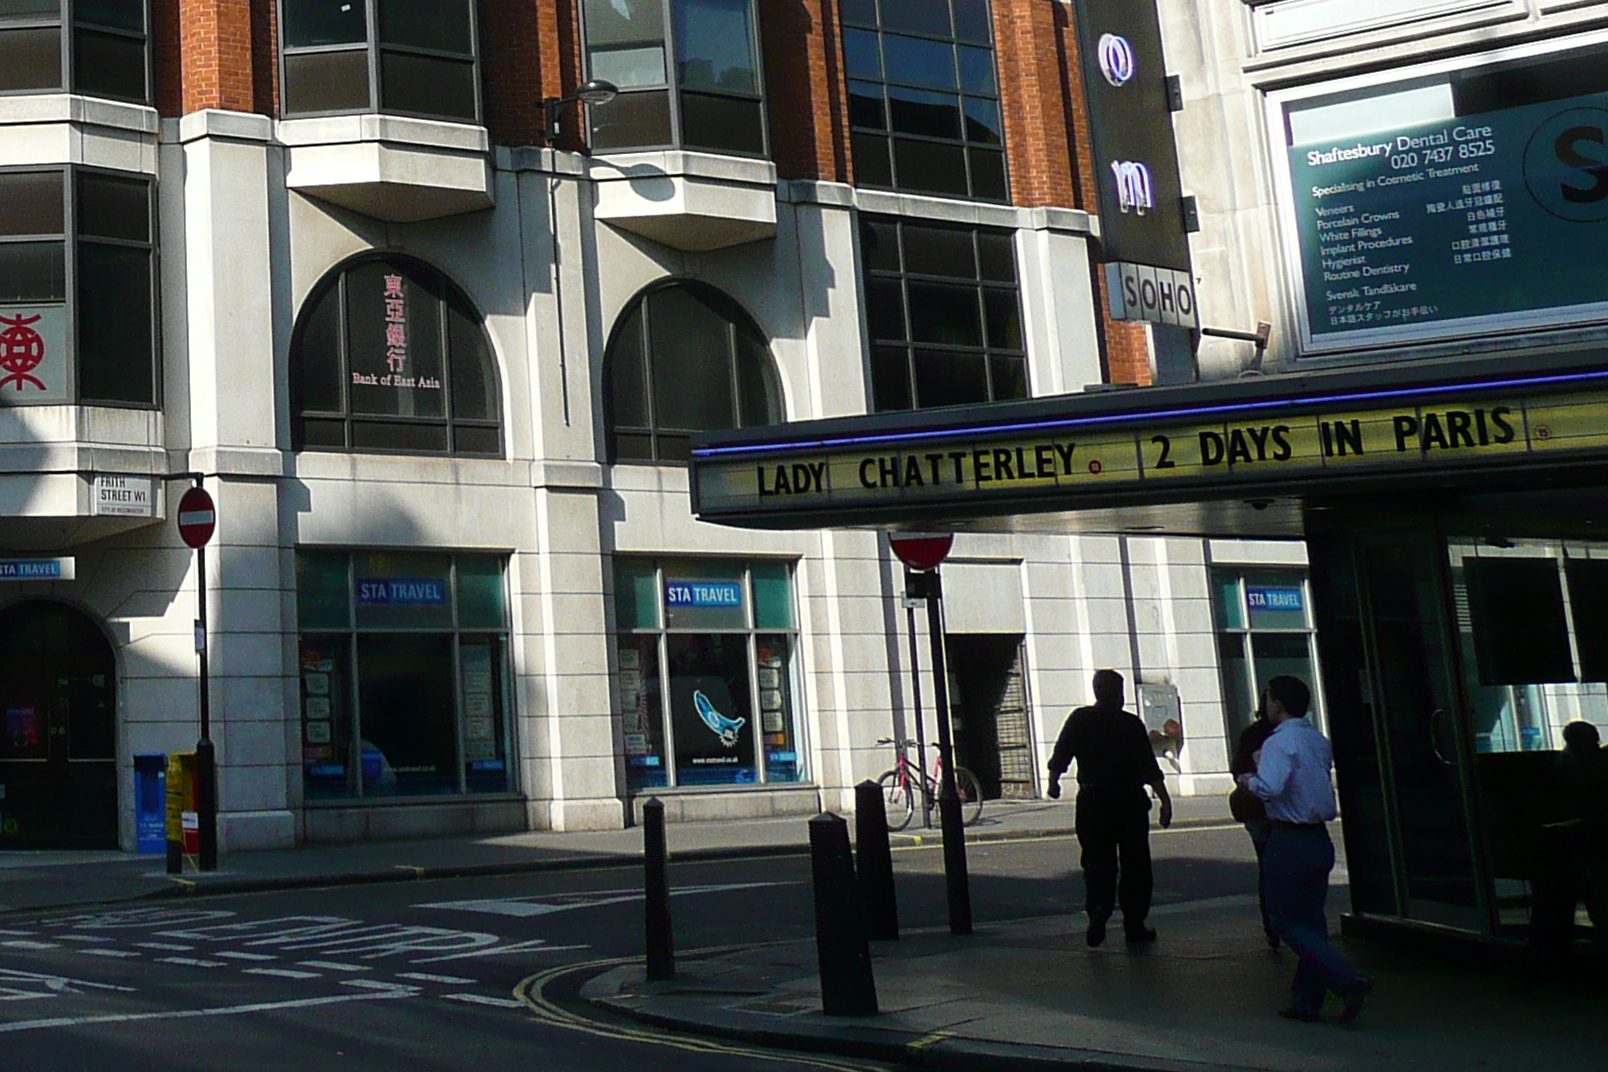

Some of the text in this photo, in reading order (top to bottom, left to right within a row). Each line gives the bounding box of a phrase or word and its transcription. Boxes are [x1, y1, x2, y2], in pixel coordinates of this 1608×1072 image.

[1307, 125, 1493, 166] Shaftesbury Dental Care
[1391, 139, 1495, 170] 020 7437 8525
[1312, 163, 1480, 198] Specialising in Cosmetic Treatment
[1315, 205, 1355, 217] Veneers
[1317, 211, 1400, 230] Porcelain Crowns
[1319, 231, 1350, 243] White
[1320, 236, 1413, 257] Implant Procedures
[1322, 256, 1366, 270] Hygienist
[1324, 263, 1410, 282] Routine Dentistry
[1125, 276, 1192, 315] SOHO
[1326, 288, 1361, 301] Svensk
[384, 274, 406, 372] 東亞銀行
[352, 373, 441, 389] Bank of East Asia
[1152, 435, 1175, 470] 2
[1199, 425, 1292, 467] DAYS
[1321, 419, 1364, 458] IN
[1393, 405, 1516, 453] PARIS
[757, 462, 825, 497] LADY
[859, 442, 1076, 490] CHATTERLEY
[101, 476, 125, 488] FRITH
[101, 489, 146, 502] STREET W1
[19, 563, 56, 575] TRAVEL
[361, 583, 441, 601] STA TRAVEL
[668, 587, 737, 604] STA TRAVEL
[1248, 592, 1300, 606] STA TRAVEL
[150, 914, 590, 964] ENTRY
